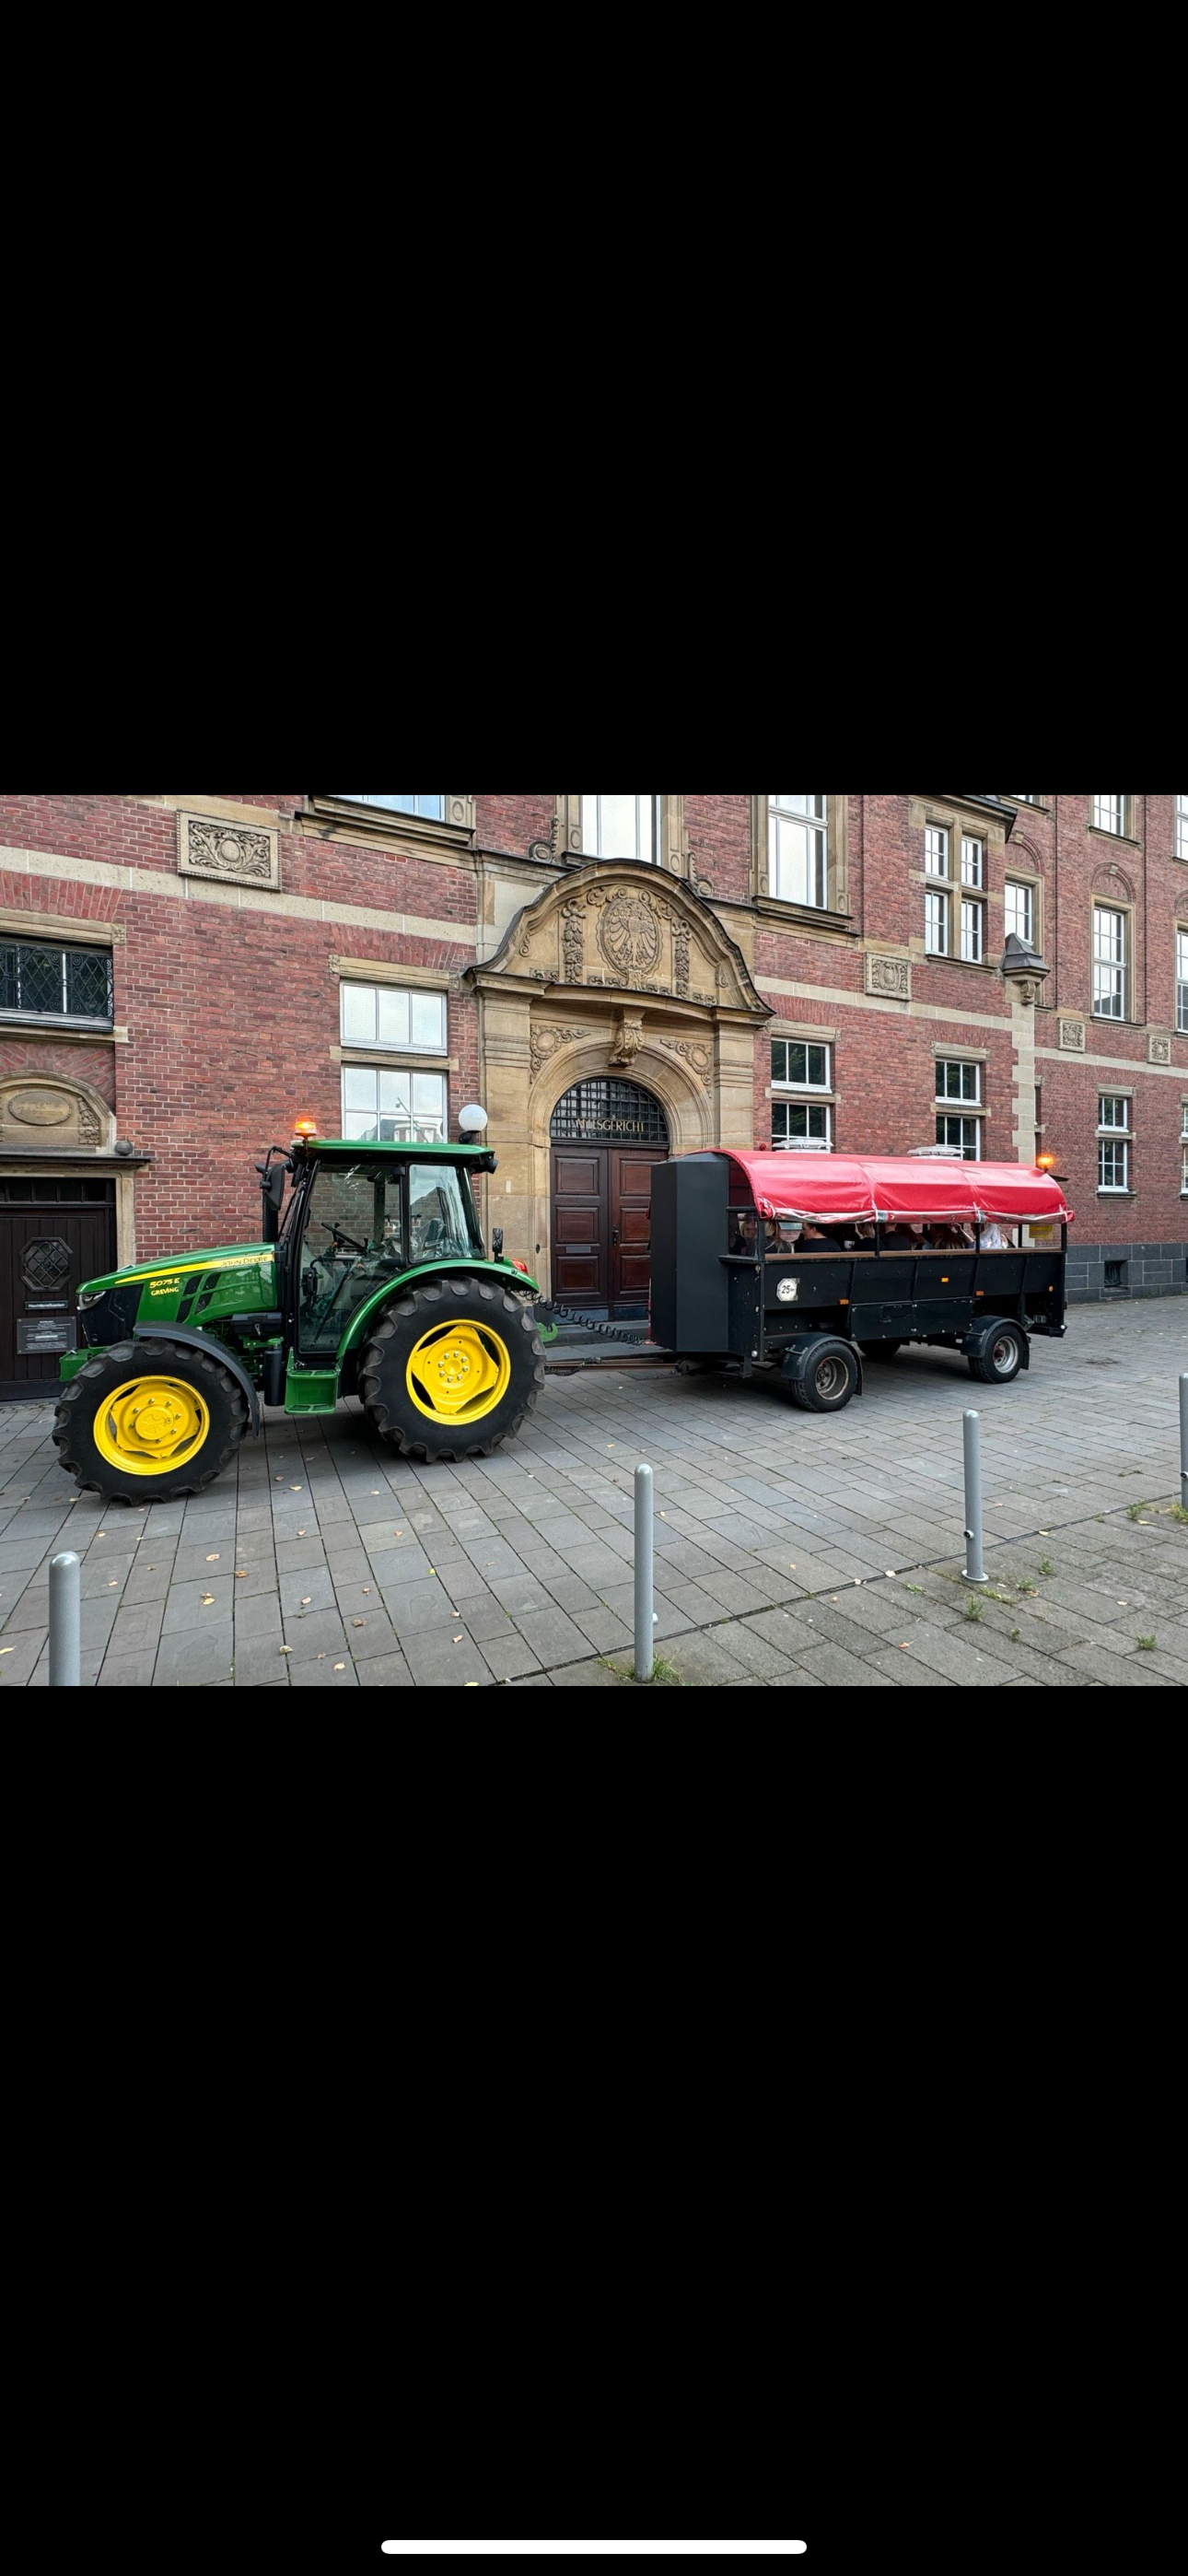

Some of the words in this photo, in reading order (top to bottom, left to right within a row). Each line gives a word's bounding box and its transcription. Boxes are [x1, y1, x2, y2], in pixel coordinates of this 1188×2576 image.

[223, 1259, 242, 1267] JOHN
[243, 1256, 268, 1264] DEERE
[149, 1278, 172, 1288] 5075
[150, 1287, 179, 1295] GREVING
[781, 1285, 790, 1294] 25
